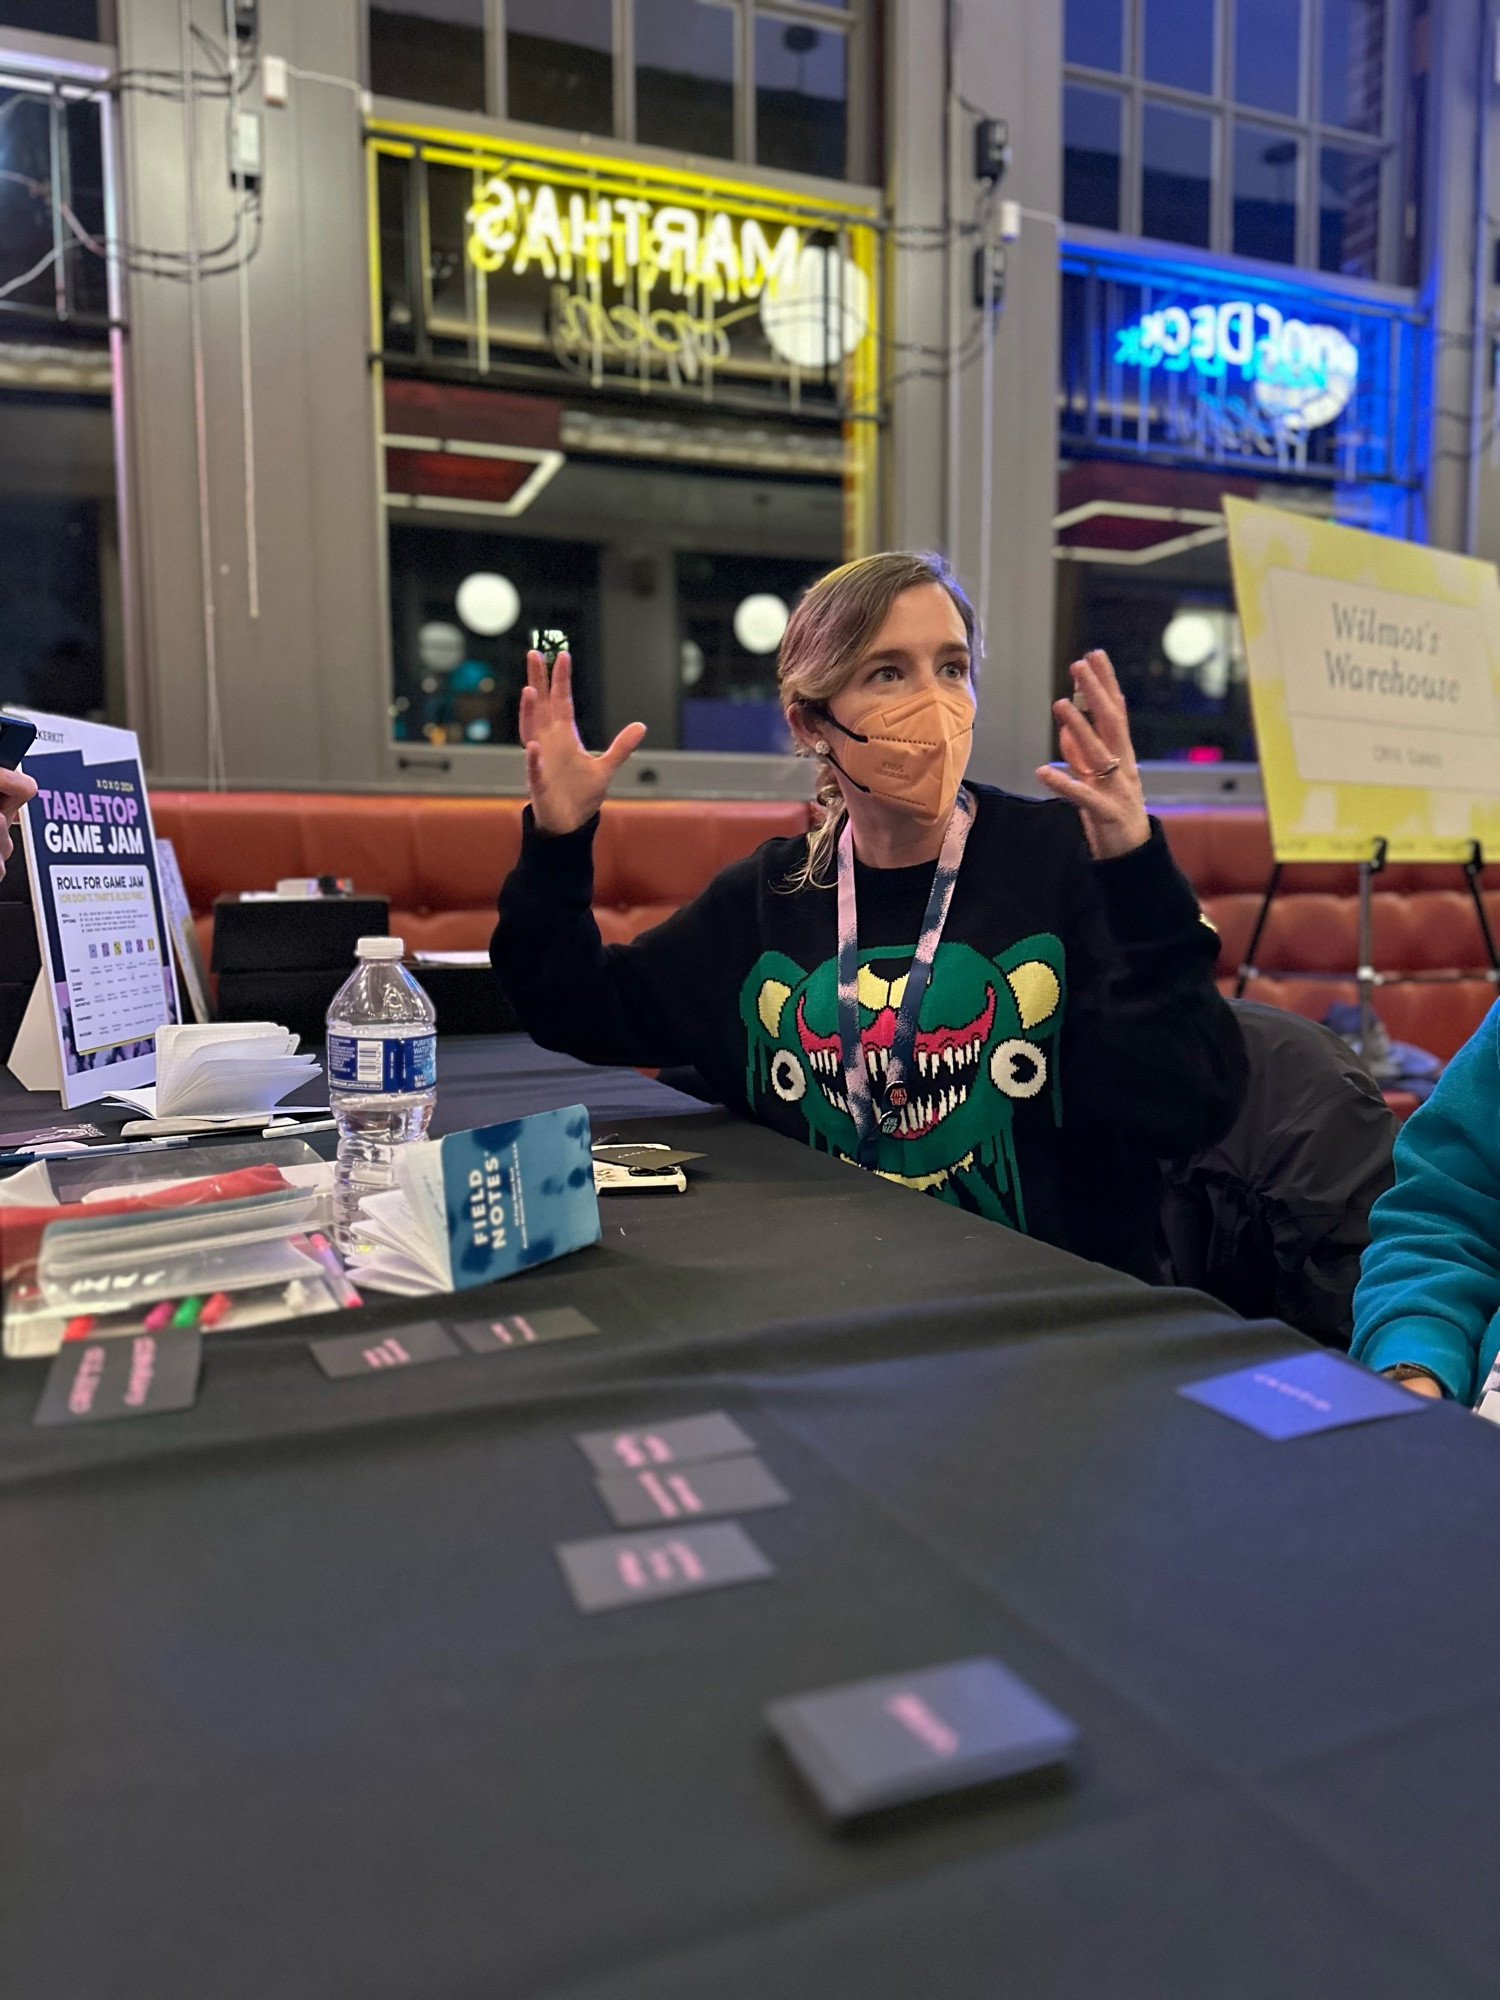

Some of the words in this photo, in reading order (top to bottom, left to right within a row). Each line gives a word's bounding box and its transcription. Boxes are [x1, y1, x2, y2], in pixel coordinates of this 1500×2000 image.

[1331, 602, 1440, 656] Wilmot's
[1325, 648, 1460, 704] Warehouse
[37, 729, 64, 744] KERKIT
[37, 789, 138, 825] TABLETOP
[44, 822, 104, 854] GAME
[107, 826, 145, 855] JAM
[56, 876, 83, 890] ROLL
[83, 876, 101, 890] FOR
[103, 876, 127, 889] GAME
[128, 875, 144, 888] JAM
[883, 1117, 898, 1126] SHE
[469, 1168, 489, 1246] FIELD
[485, 1156, 506, 1250] NOTES
